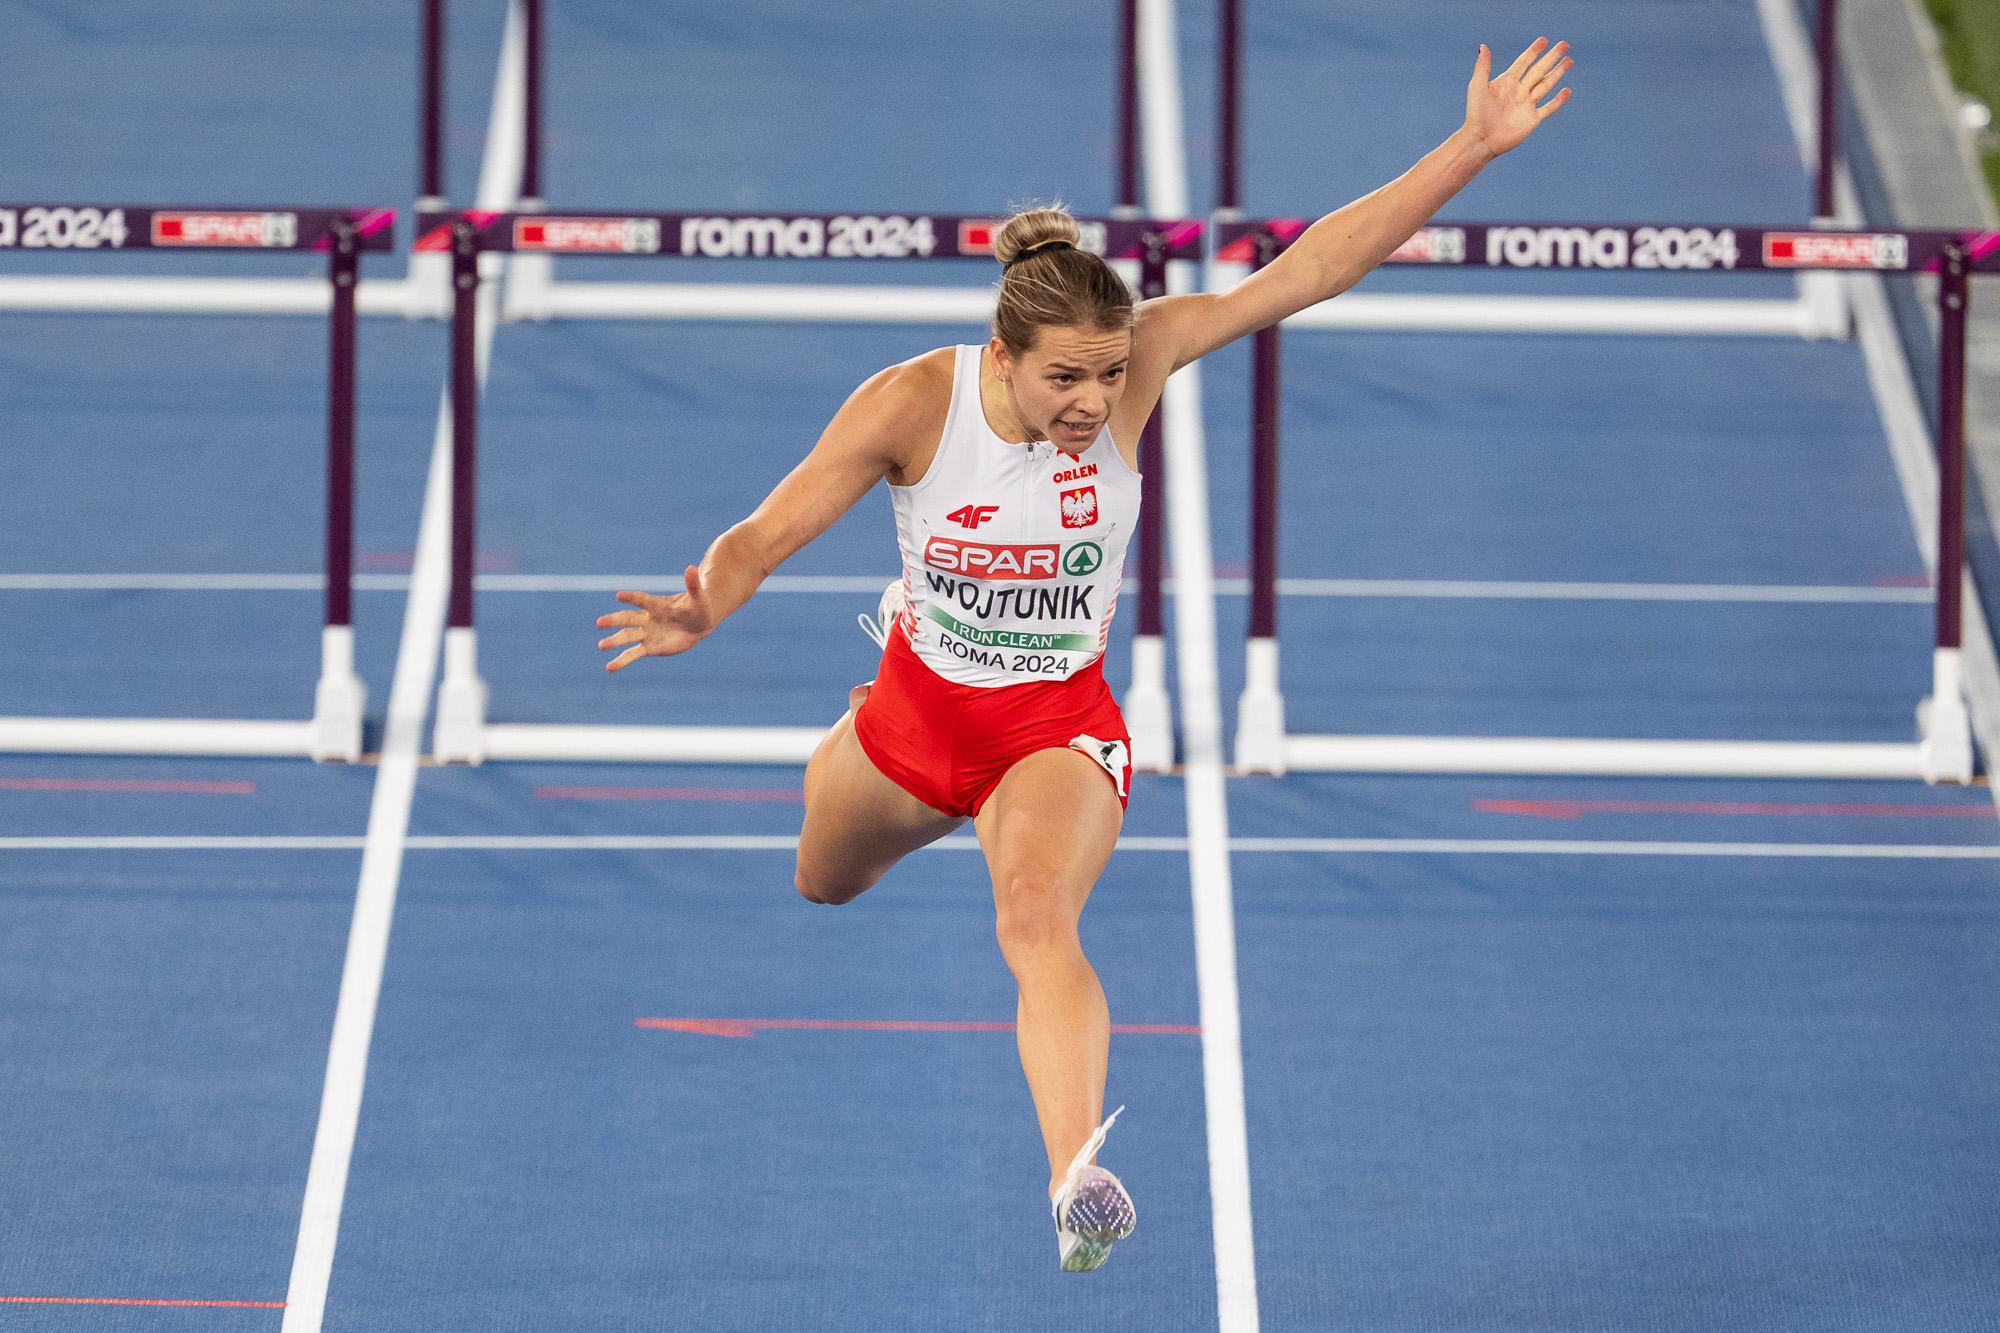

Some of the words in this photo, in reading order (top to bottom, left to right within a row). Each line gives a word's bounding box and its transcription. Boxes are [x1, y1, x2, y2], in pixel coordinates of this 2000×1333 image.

[21, 207, 129, 248] 2024
[681, 217, 823, 257] roma
[827, 216, 937, 257] 2024
[1486, 227, 1628, 268] roma
[1632, 227, 1740, 269] 2024
[1053, 463, 1098, 484] ORLEN
[946, 505, 1000, 529] 4F
[928, 542, 1058, 575] SPAR
[925, 571, 1095, 621] WOJTUNIK
[952, 620, 957, 632] I
[959, 624, 994, 645] RUN
[939, 632, 1006, 670] ROMA
[1012, 655, 1070, 675] 2024
